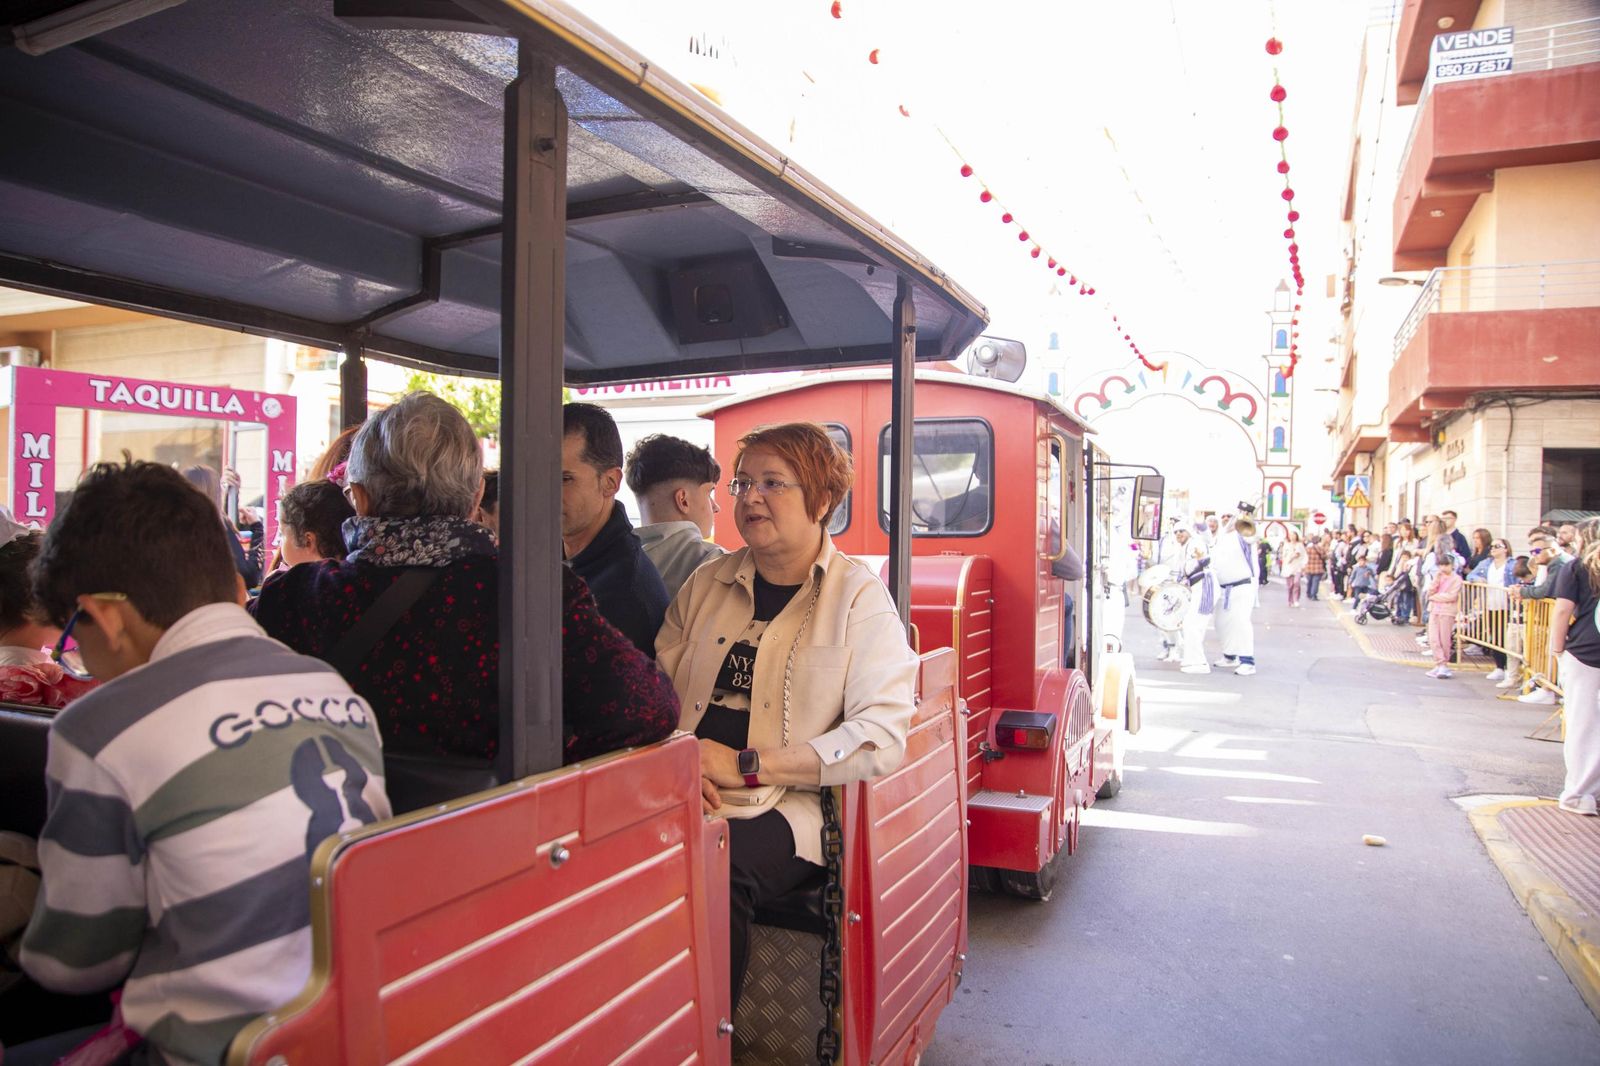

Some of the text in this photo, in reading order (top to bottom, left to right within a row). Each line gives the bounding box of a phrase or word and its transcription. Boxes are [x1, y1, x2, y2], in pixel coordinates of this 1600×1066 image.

[1440, 28, 1511, 50] VENDE
[1463, 62, 1478, 74] 27
[1479, 60, 1496, 73] 25
[1496, 58, 1510, 72] 17
[89, 378, 245, 416] TAQUILLA
[727, 653, 754, 672] NY
[732, 671, 752, 689] 82
[209, 697, 367, 750] GOCCO
